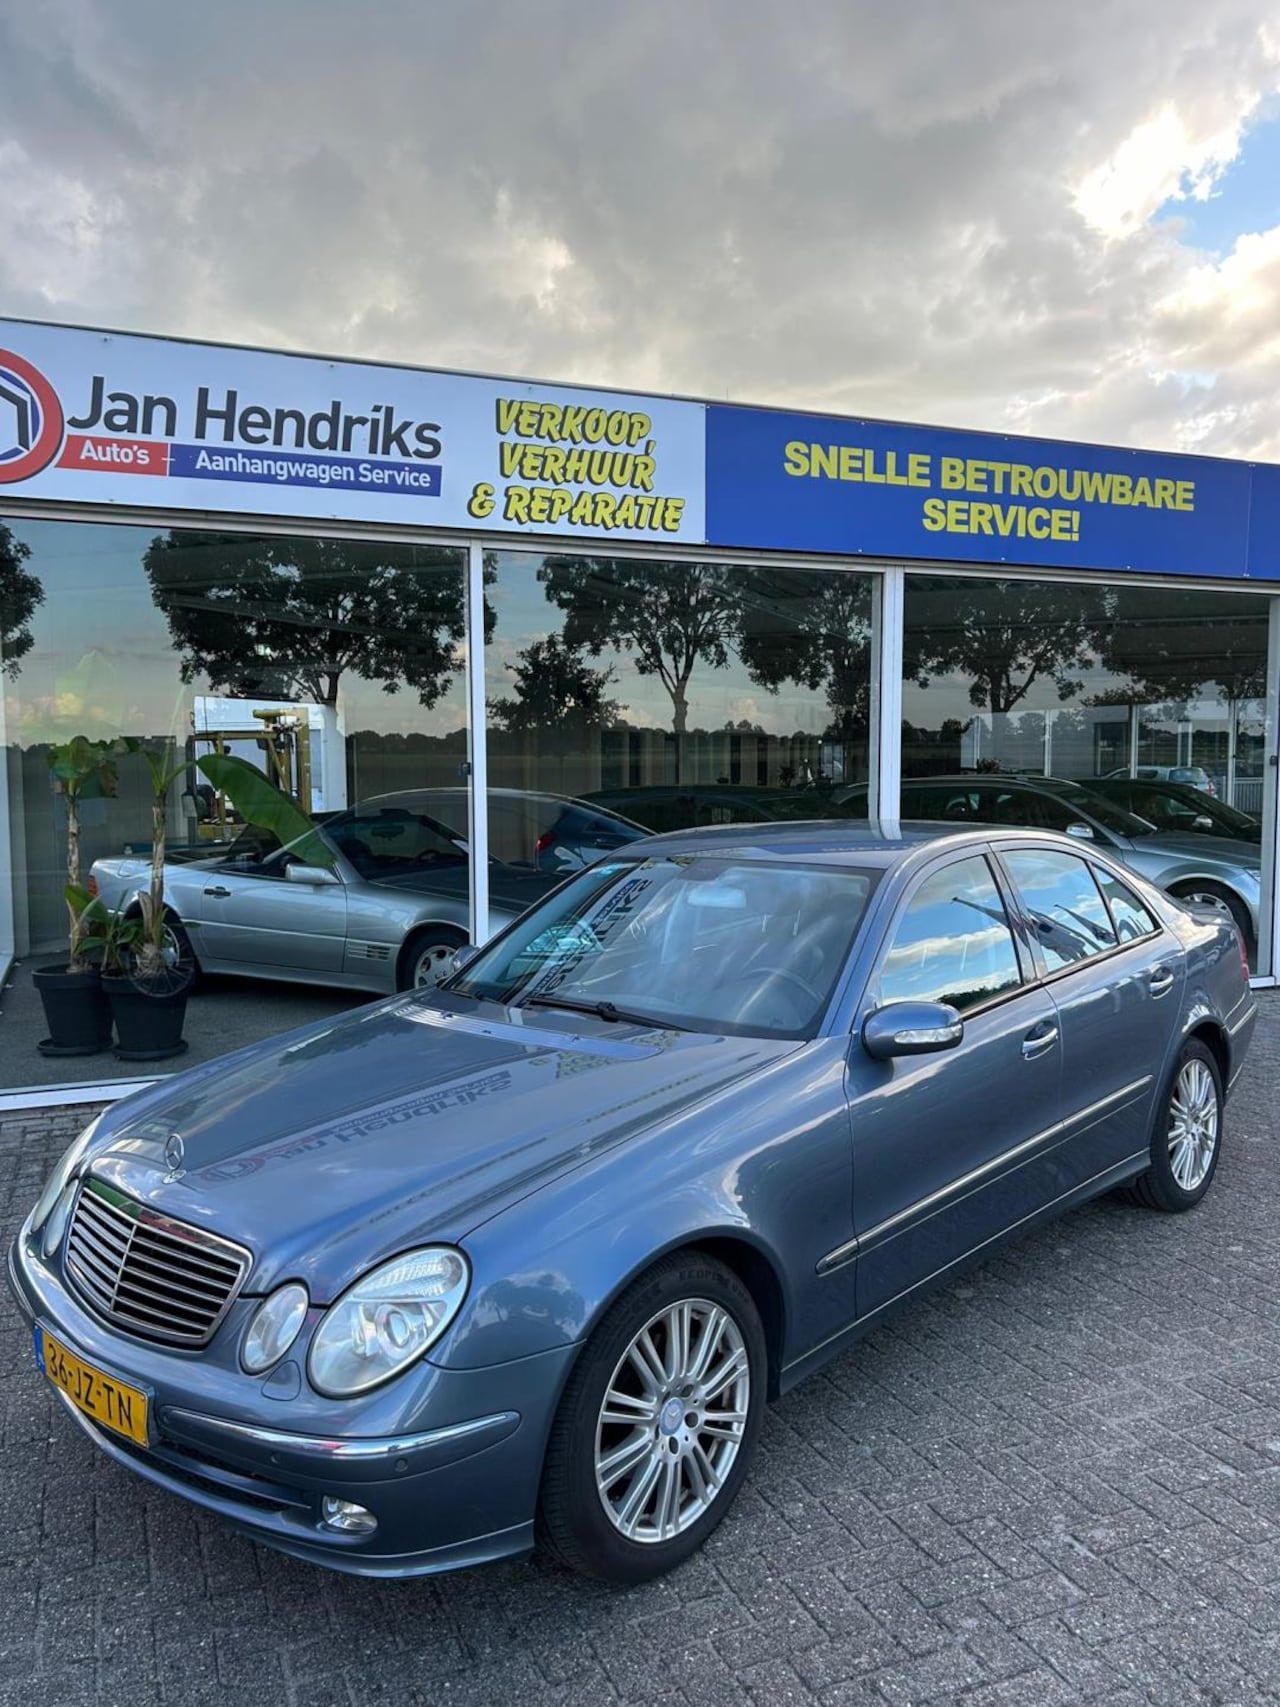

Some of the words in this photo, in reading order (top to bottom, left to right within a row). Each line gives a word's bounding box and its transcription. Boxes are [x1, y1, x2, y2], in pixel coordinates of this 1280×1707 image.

[67, 376, 177, 437] Jan
[194, 387, 442, 459] Hendriks
[496, 398, 656, 456] VERKOOP,
[80, 439, 150, 465] Auto's
[195, 450, 355, 483] Aanhangwagen
[358, 466, 431, 488] Service
[500, 441, 656, 492] VERHUUR
[784, 441, 931, 488] SNELLE
[940, 457, 1195, 511] BETROUWBARE
[467, 482, 496, 519] &
[504, 485, 686, 532] REPARATIE
[922, 499, 1081, 541] SERVICE!
[48, 1342, 134, 1430] 36-JZ-TN
